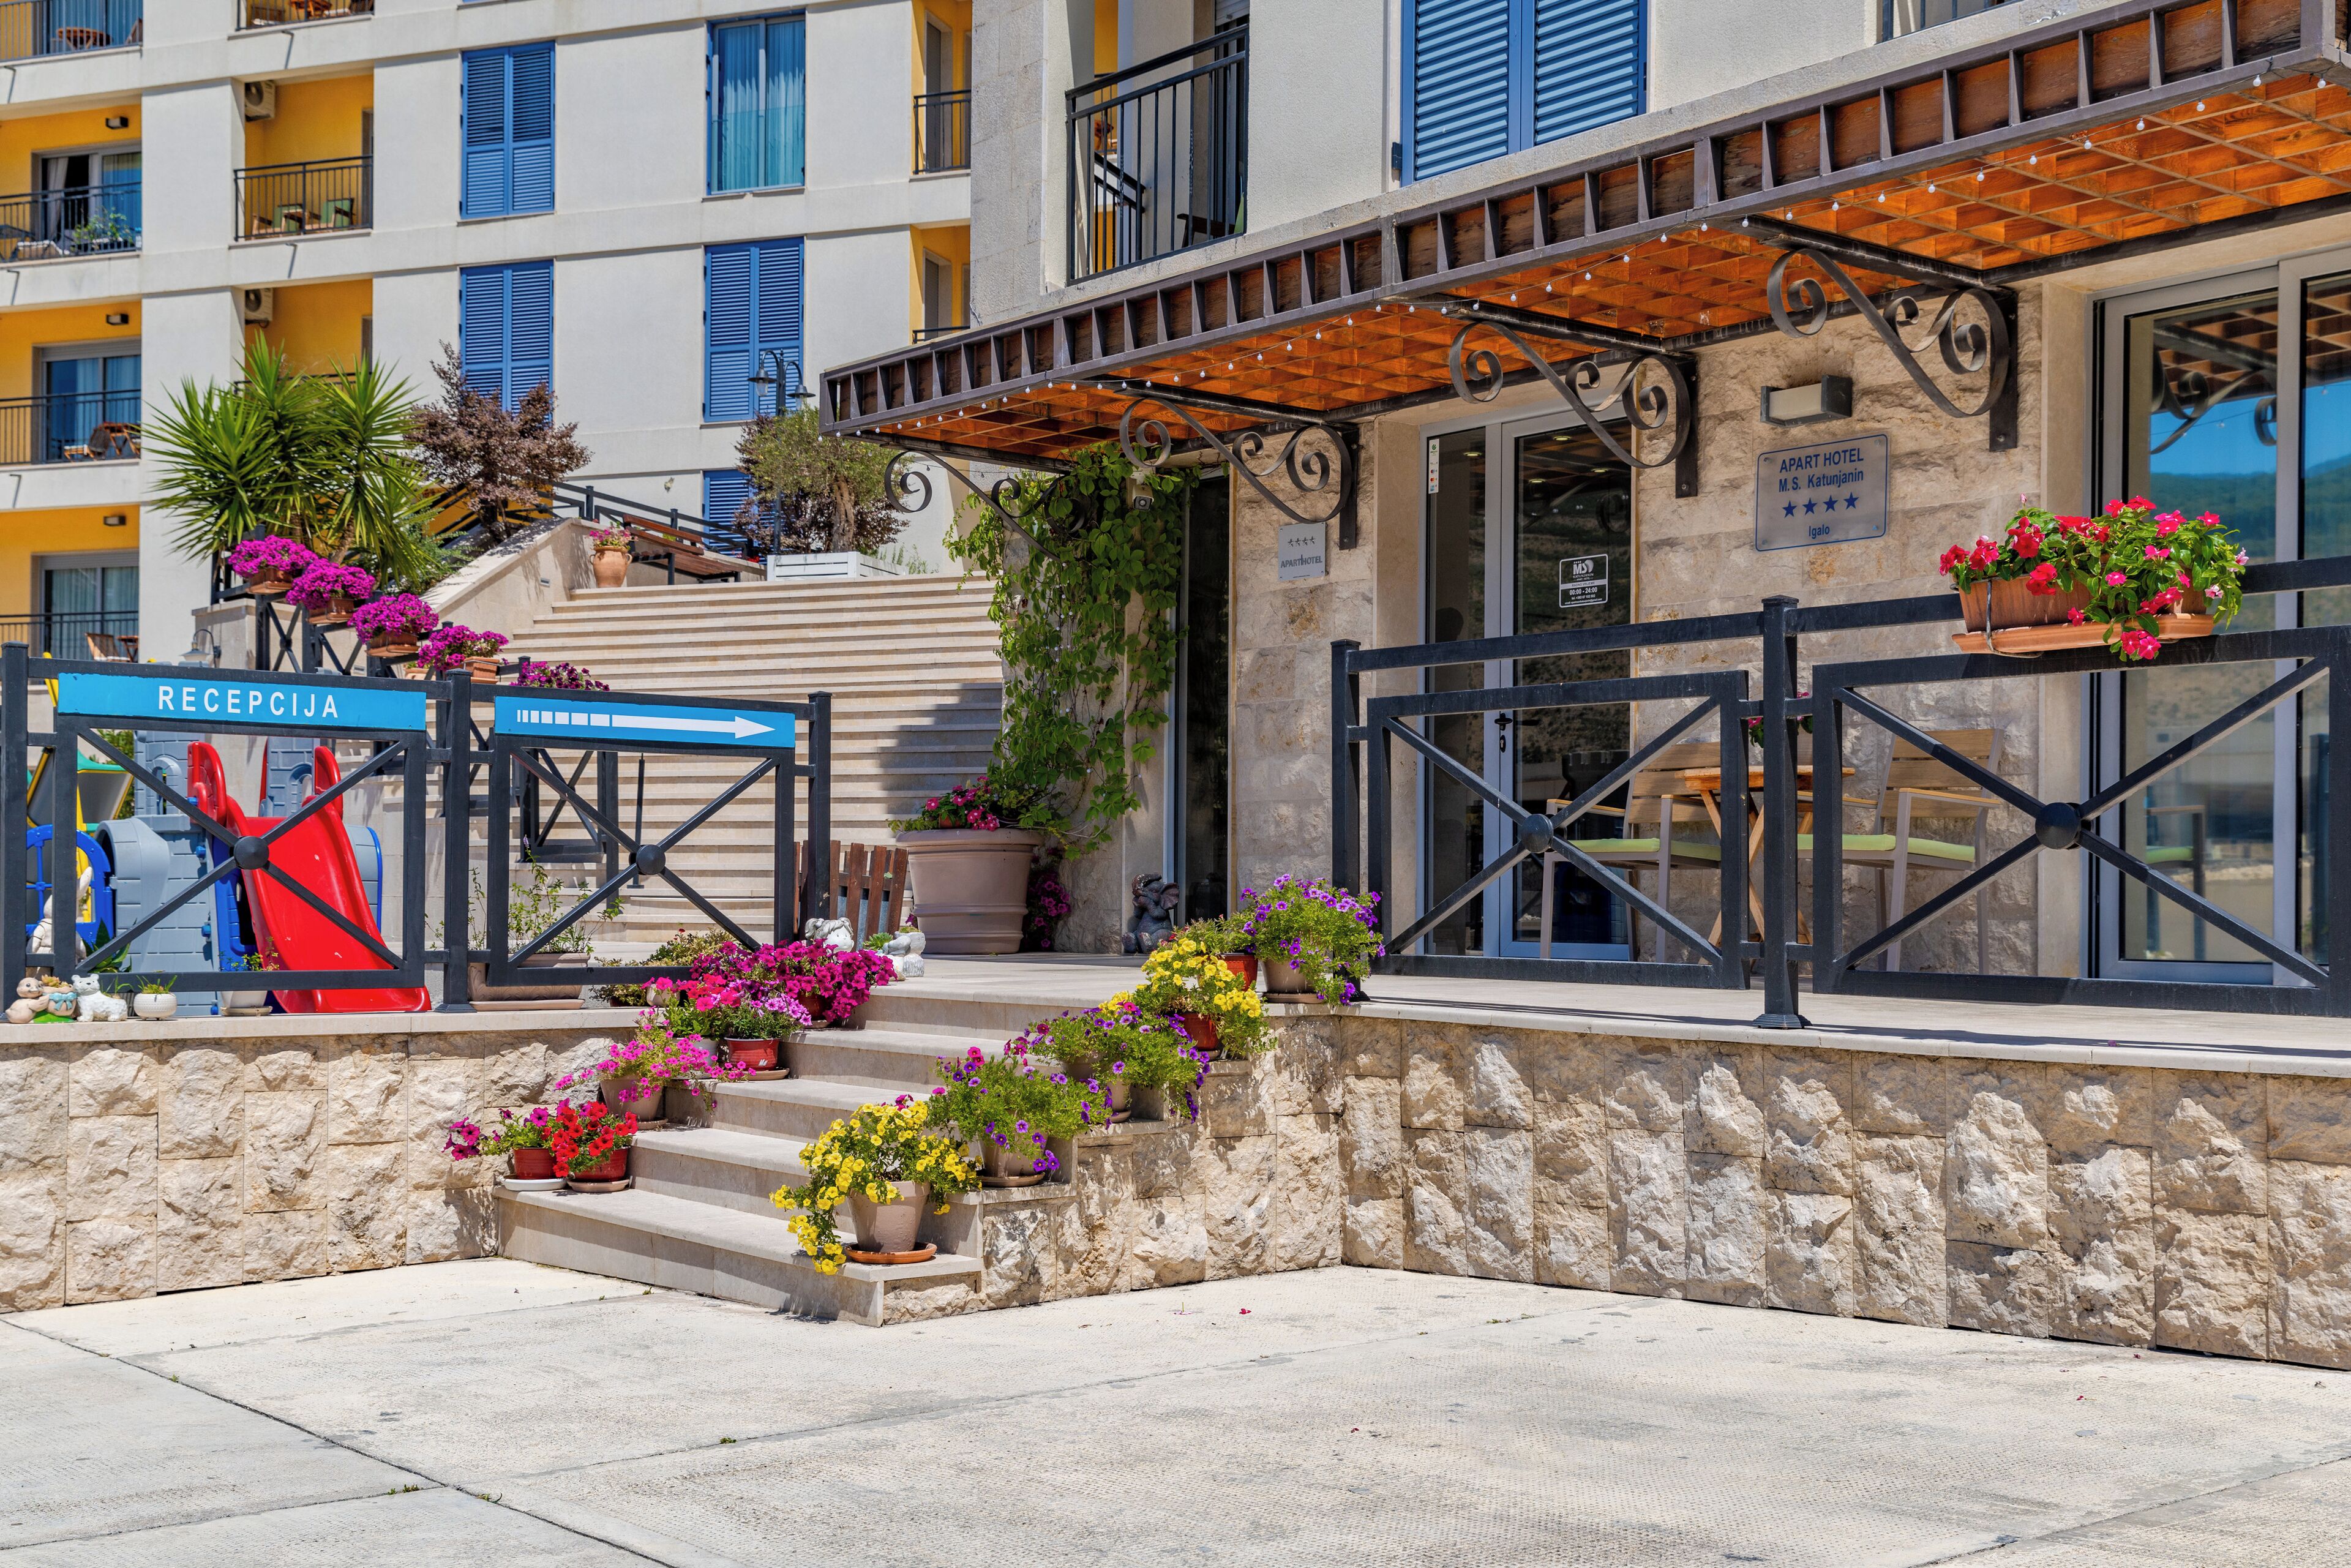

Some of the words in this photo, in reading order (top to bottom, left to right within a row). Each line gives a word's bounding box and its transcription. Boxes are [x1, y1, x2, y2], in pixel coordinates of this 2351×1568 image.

[1779, 454, 1820, 473] APART
[1823, 448, 1864, 467] HOTEL
[1807, 468, 1864, 488] Katunjanin
[1809, 524, 1830, 539] Igalo
[159, 686, 338, 718] RECEPCIJA
